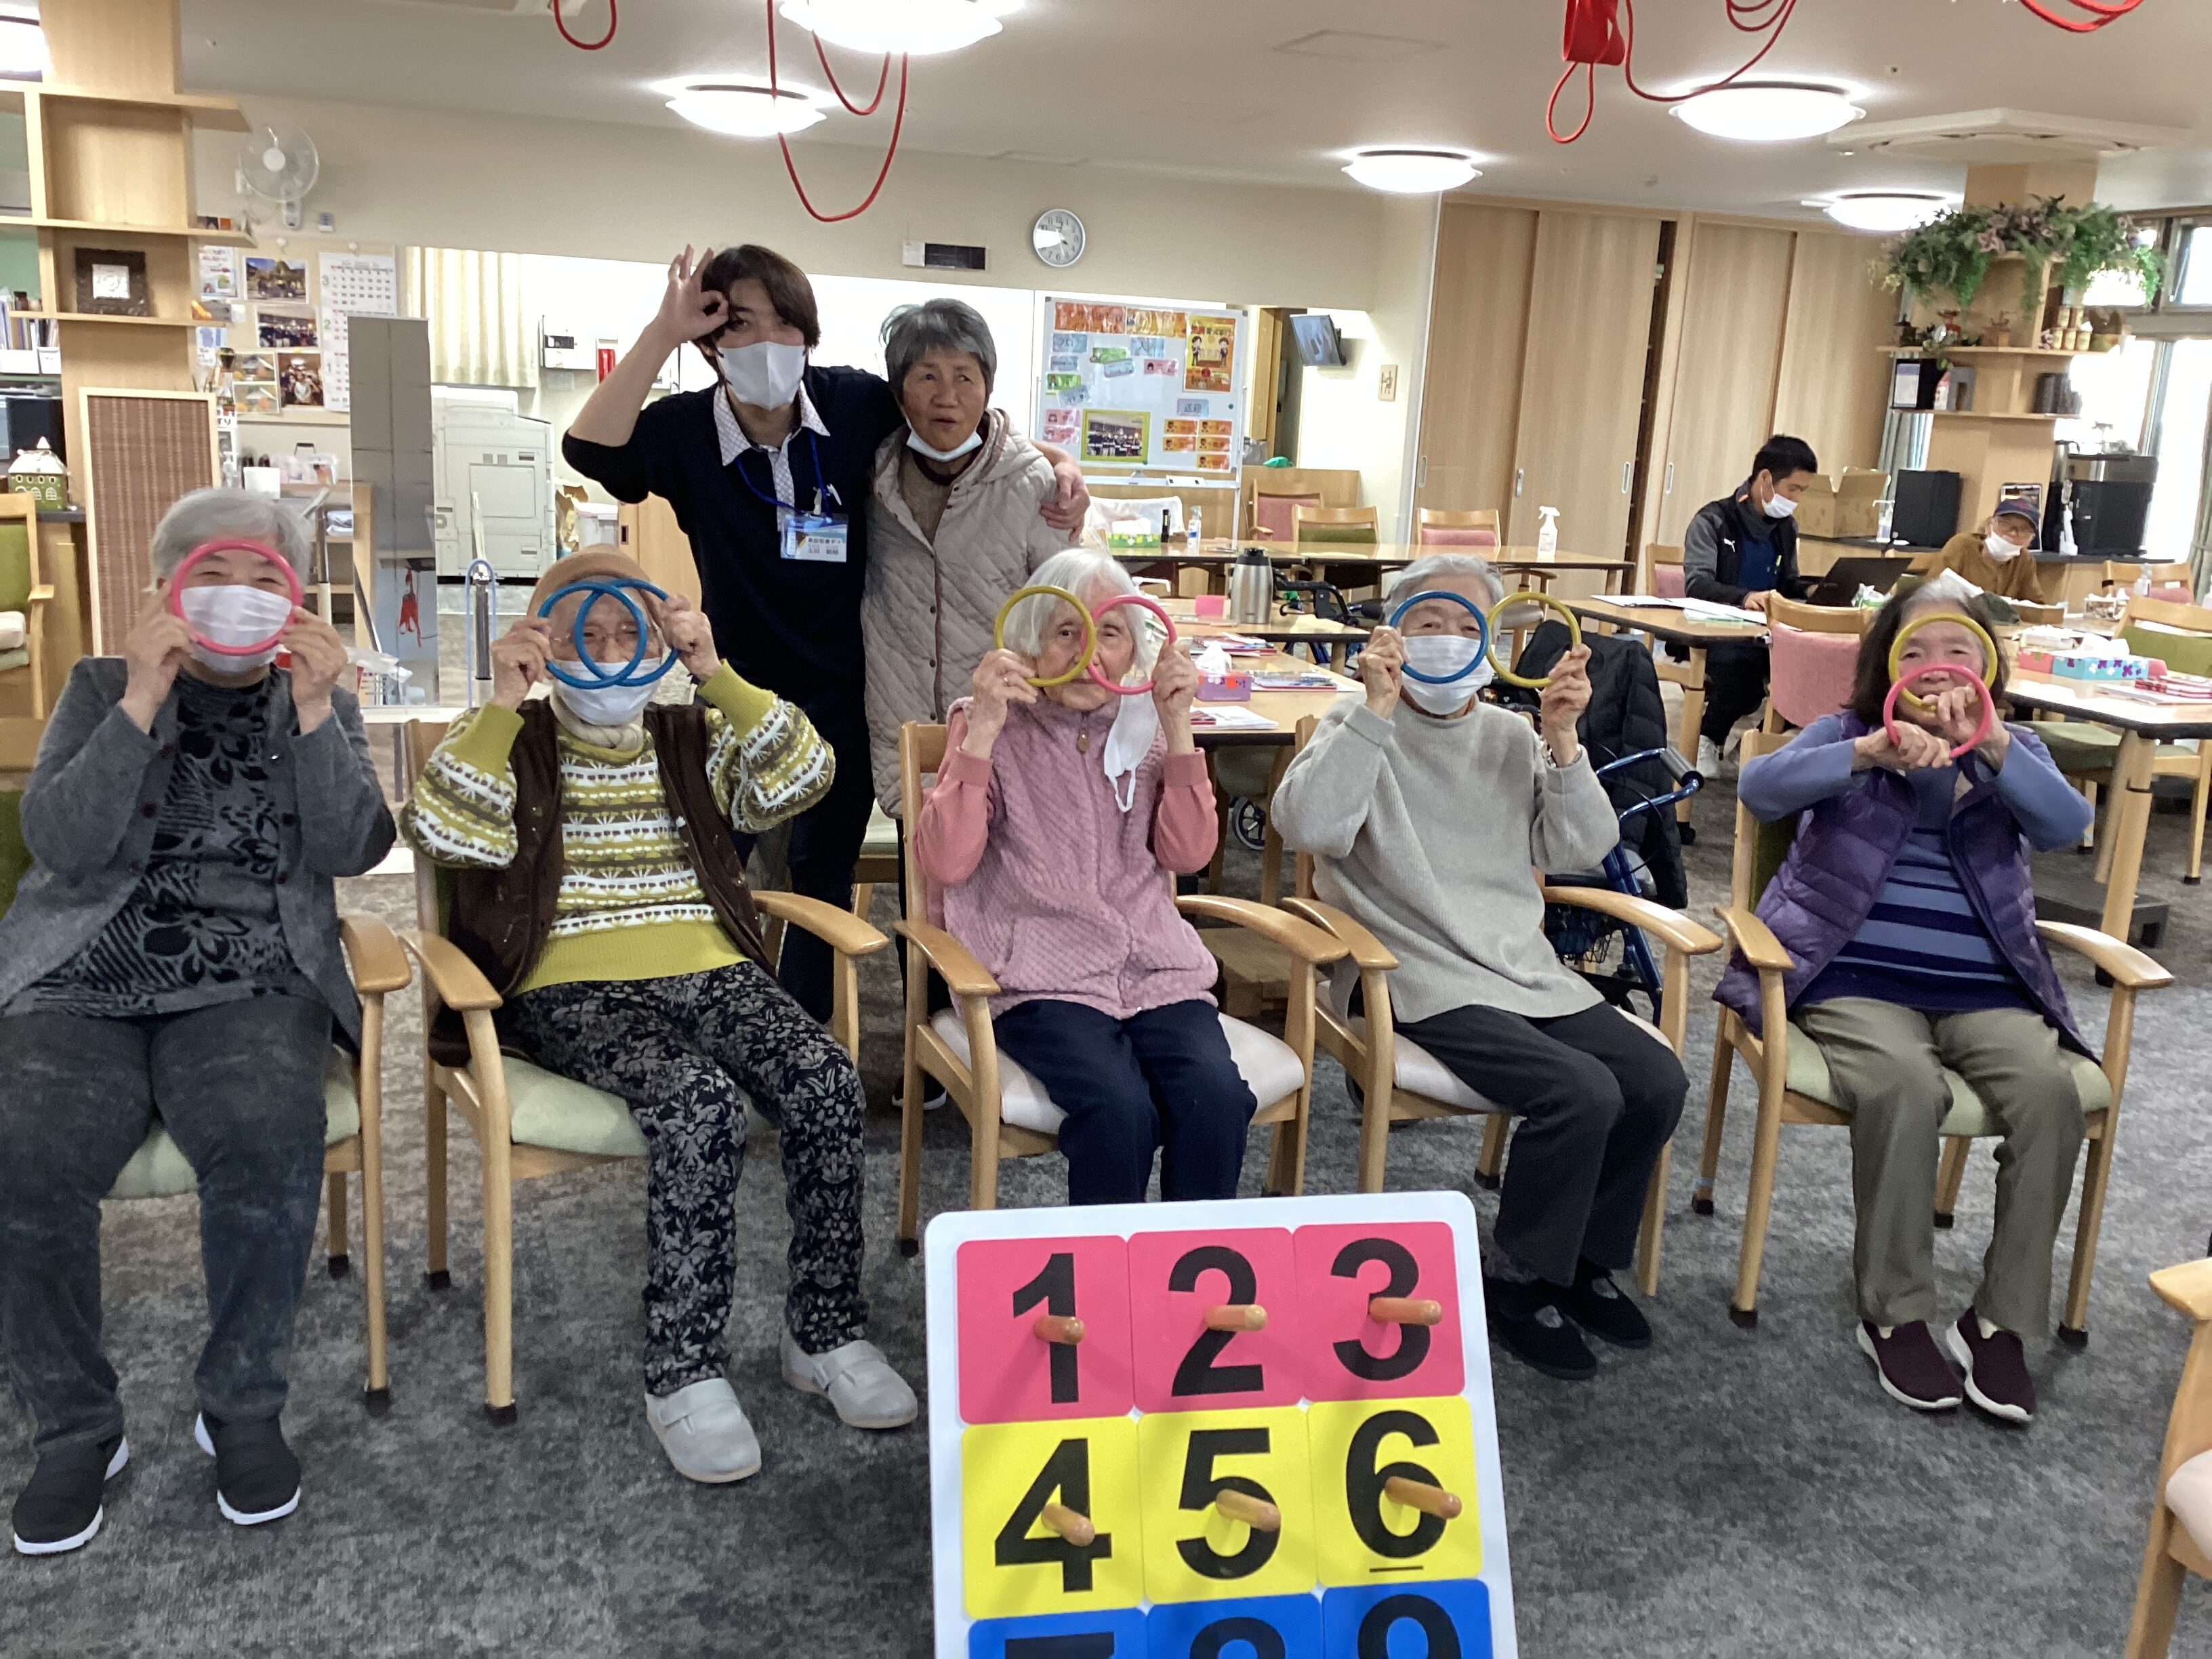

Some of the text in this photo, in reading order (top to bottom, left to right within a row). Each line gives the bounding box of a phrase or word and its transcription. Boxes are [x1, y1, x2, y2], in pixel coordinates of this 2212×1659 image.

[323, 275, 329, 286] 3
[324, 319, 331, 330] 2
[327, 363, 331, 372] 1
[1012, 1238, 1432, 1404] 1 2 3
[994, 1410, 1449, 1593] 4 5 6
